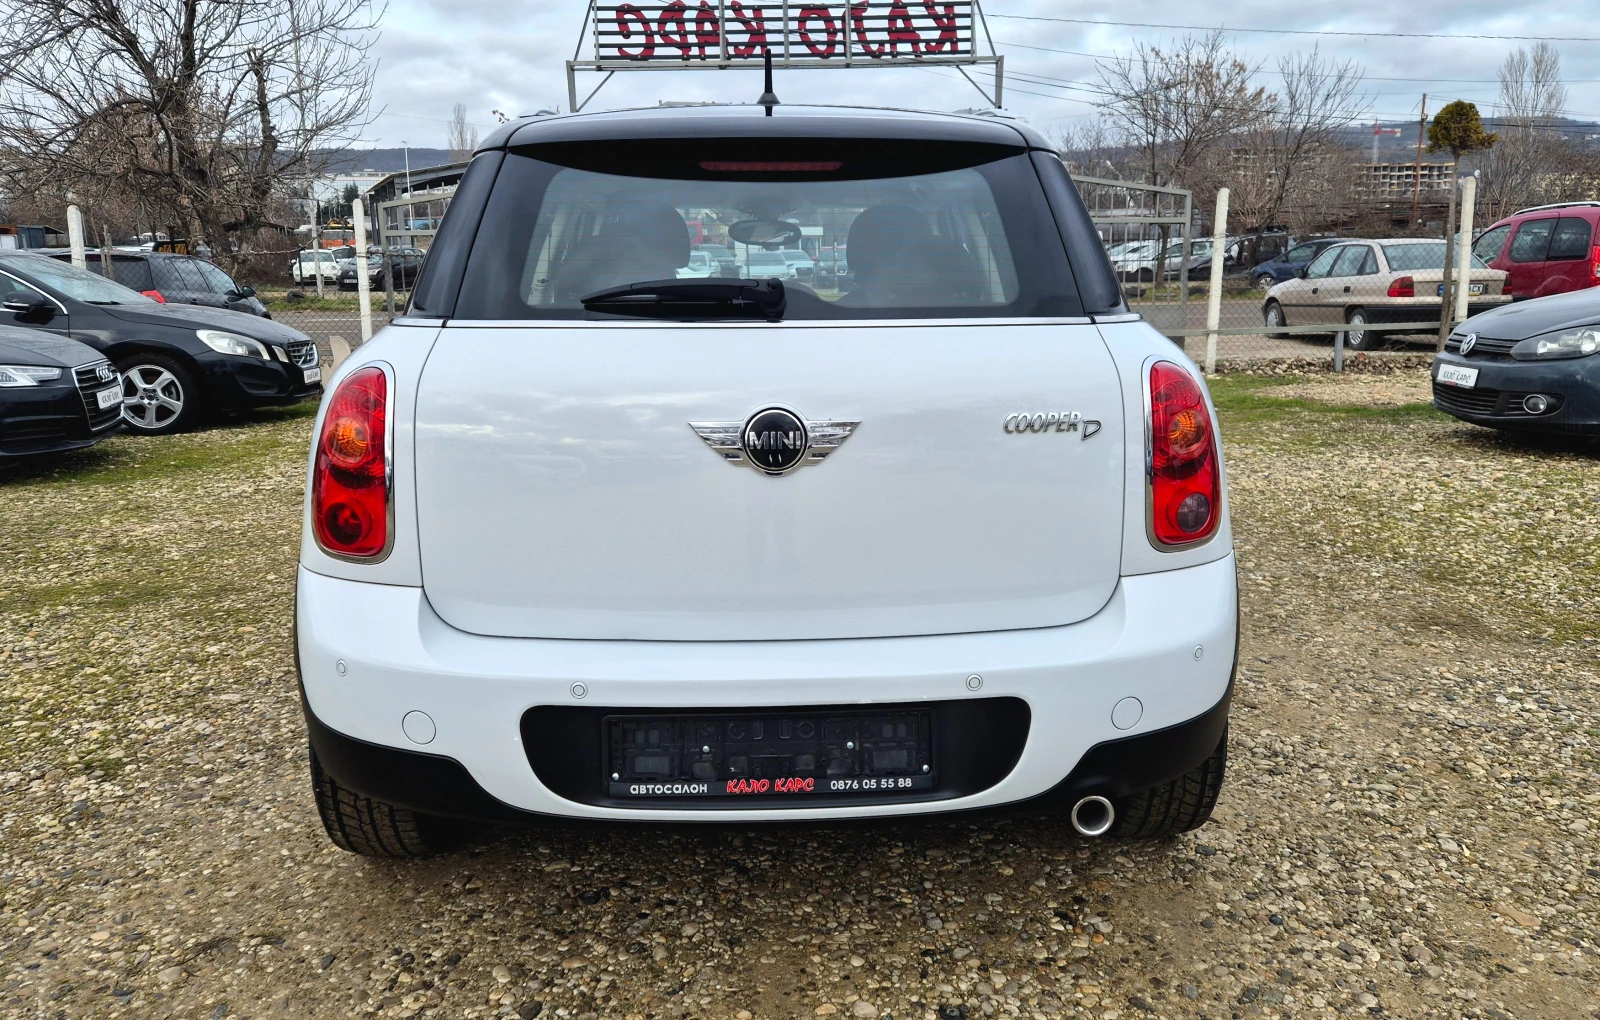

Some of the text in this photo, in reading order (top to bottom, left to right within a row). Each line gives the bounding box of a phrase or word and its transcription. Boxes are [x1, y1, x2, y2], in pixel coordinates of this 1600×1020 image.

[1003, 411, 1102, 441] COOPER D
[749, 431, 801, 450] MINI
[629, 777, 913, 794] автосалон КАЛО КАРС 0876 05 55 88
